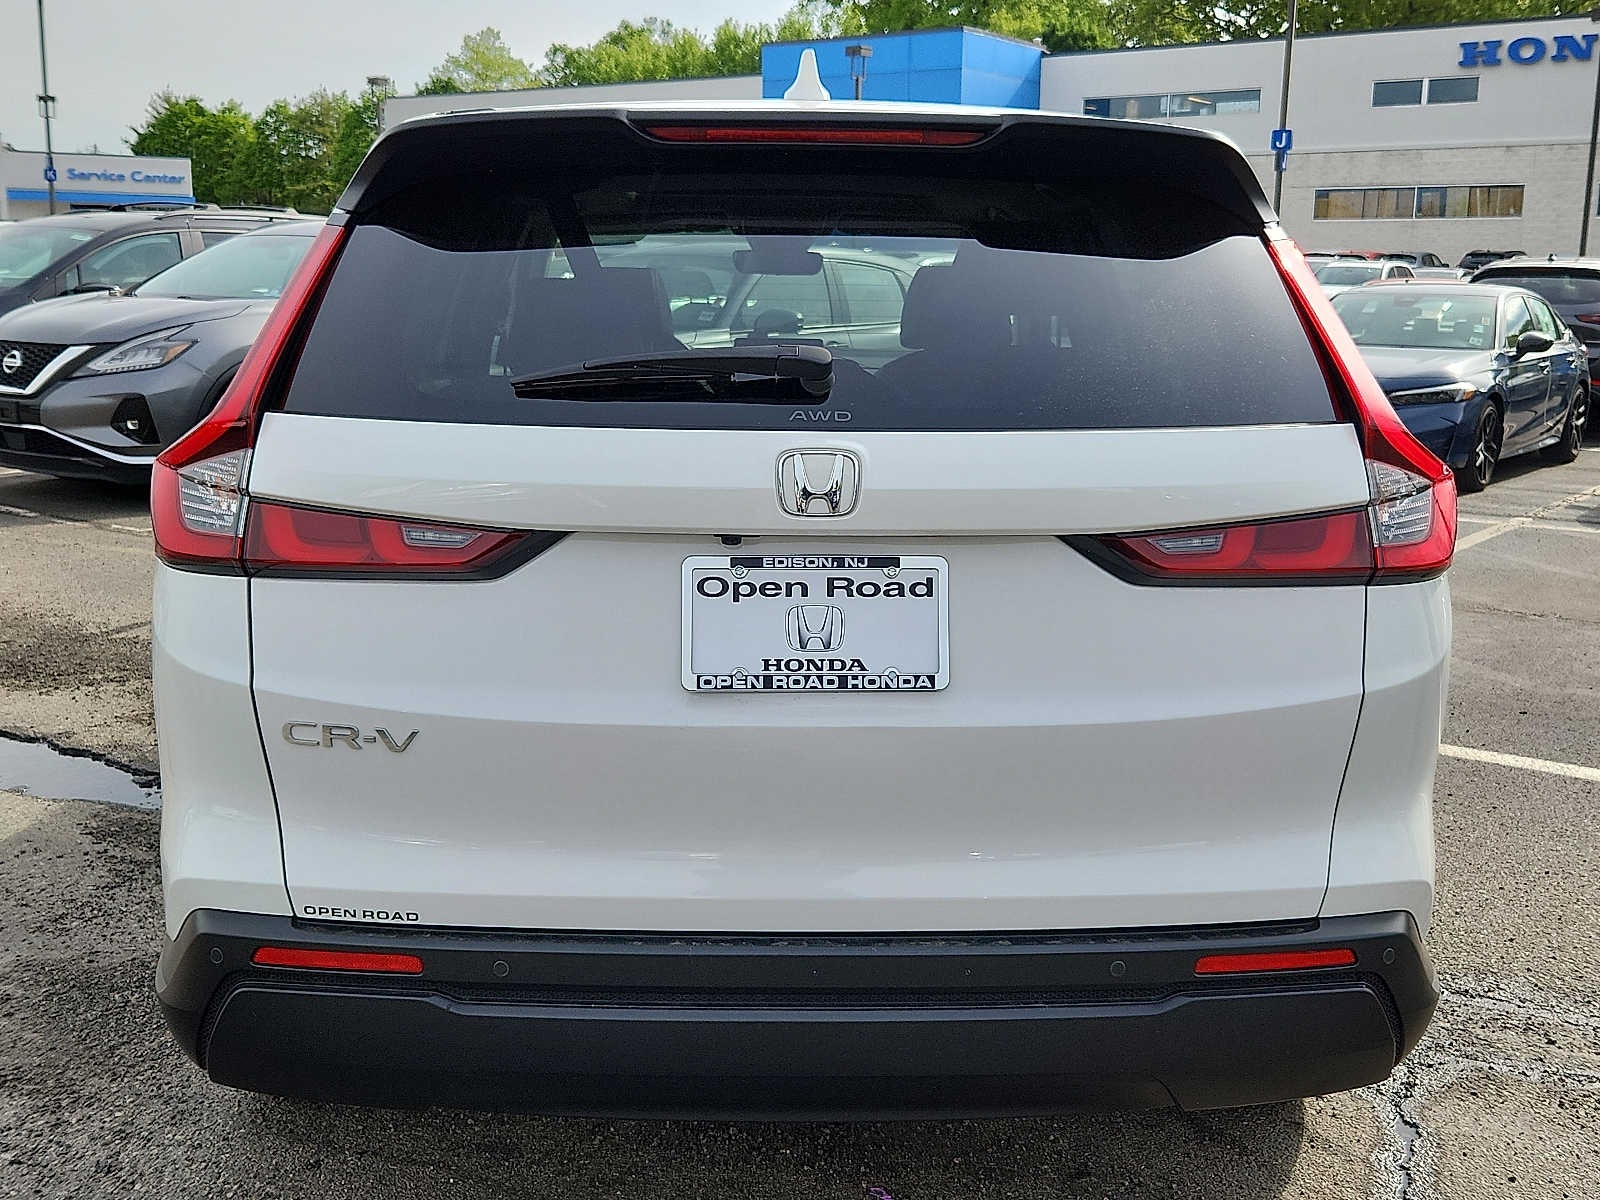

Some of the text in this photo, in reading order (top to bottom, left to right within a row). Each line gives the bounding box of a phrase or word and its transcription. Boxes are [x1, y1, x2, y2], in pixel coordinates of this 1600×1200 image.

[1275, 132, 1286, 148] J
[67, 168, 185, 184] Service Center
[789, 410, 852, 422] AWD
[762, 557, 869, 569] EDISON, NJ
[696, 576, 934, 603] Open Road
[761, 658, 869, 672] HONDA
[699, 675, 935, 689] OPEN ROAD HONDA
[282, 721, 420, 753] CR-V
[303, 905, 420, 922] OPEN ROAD
